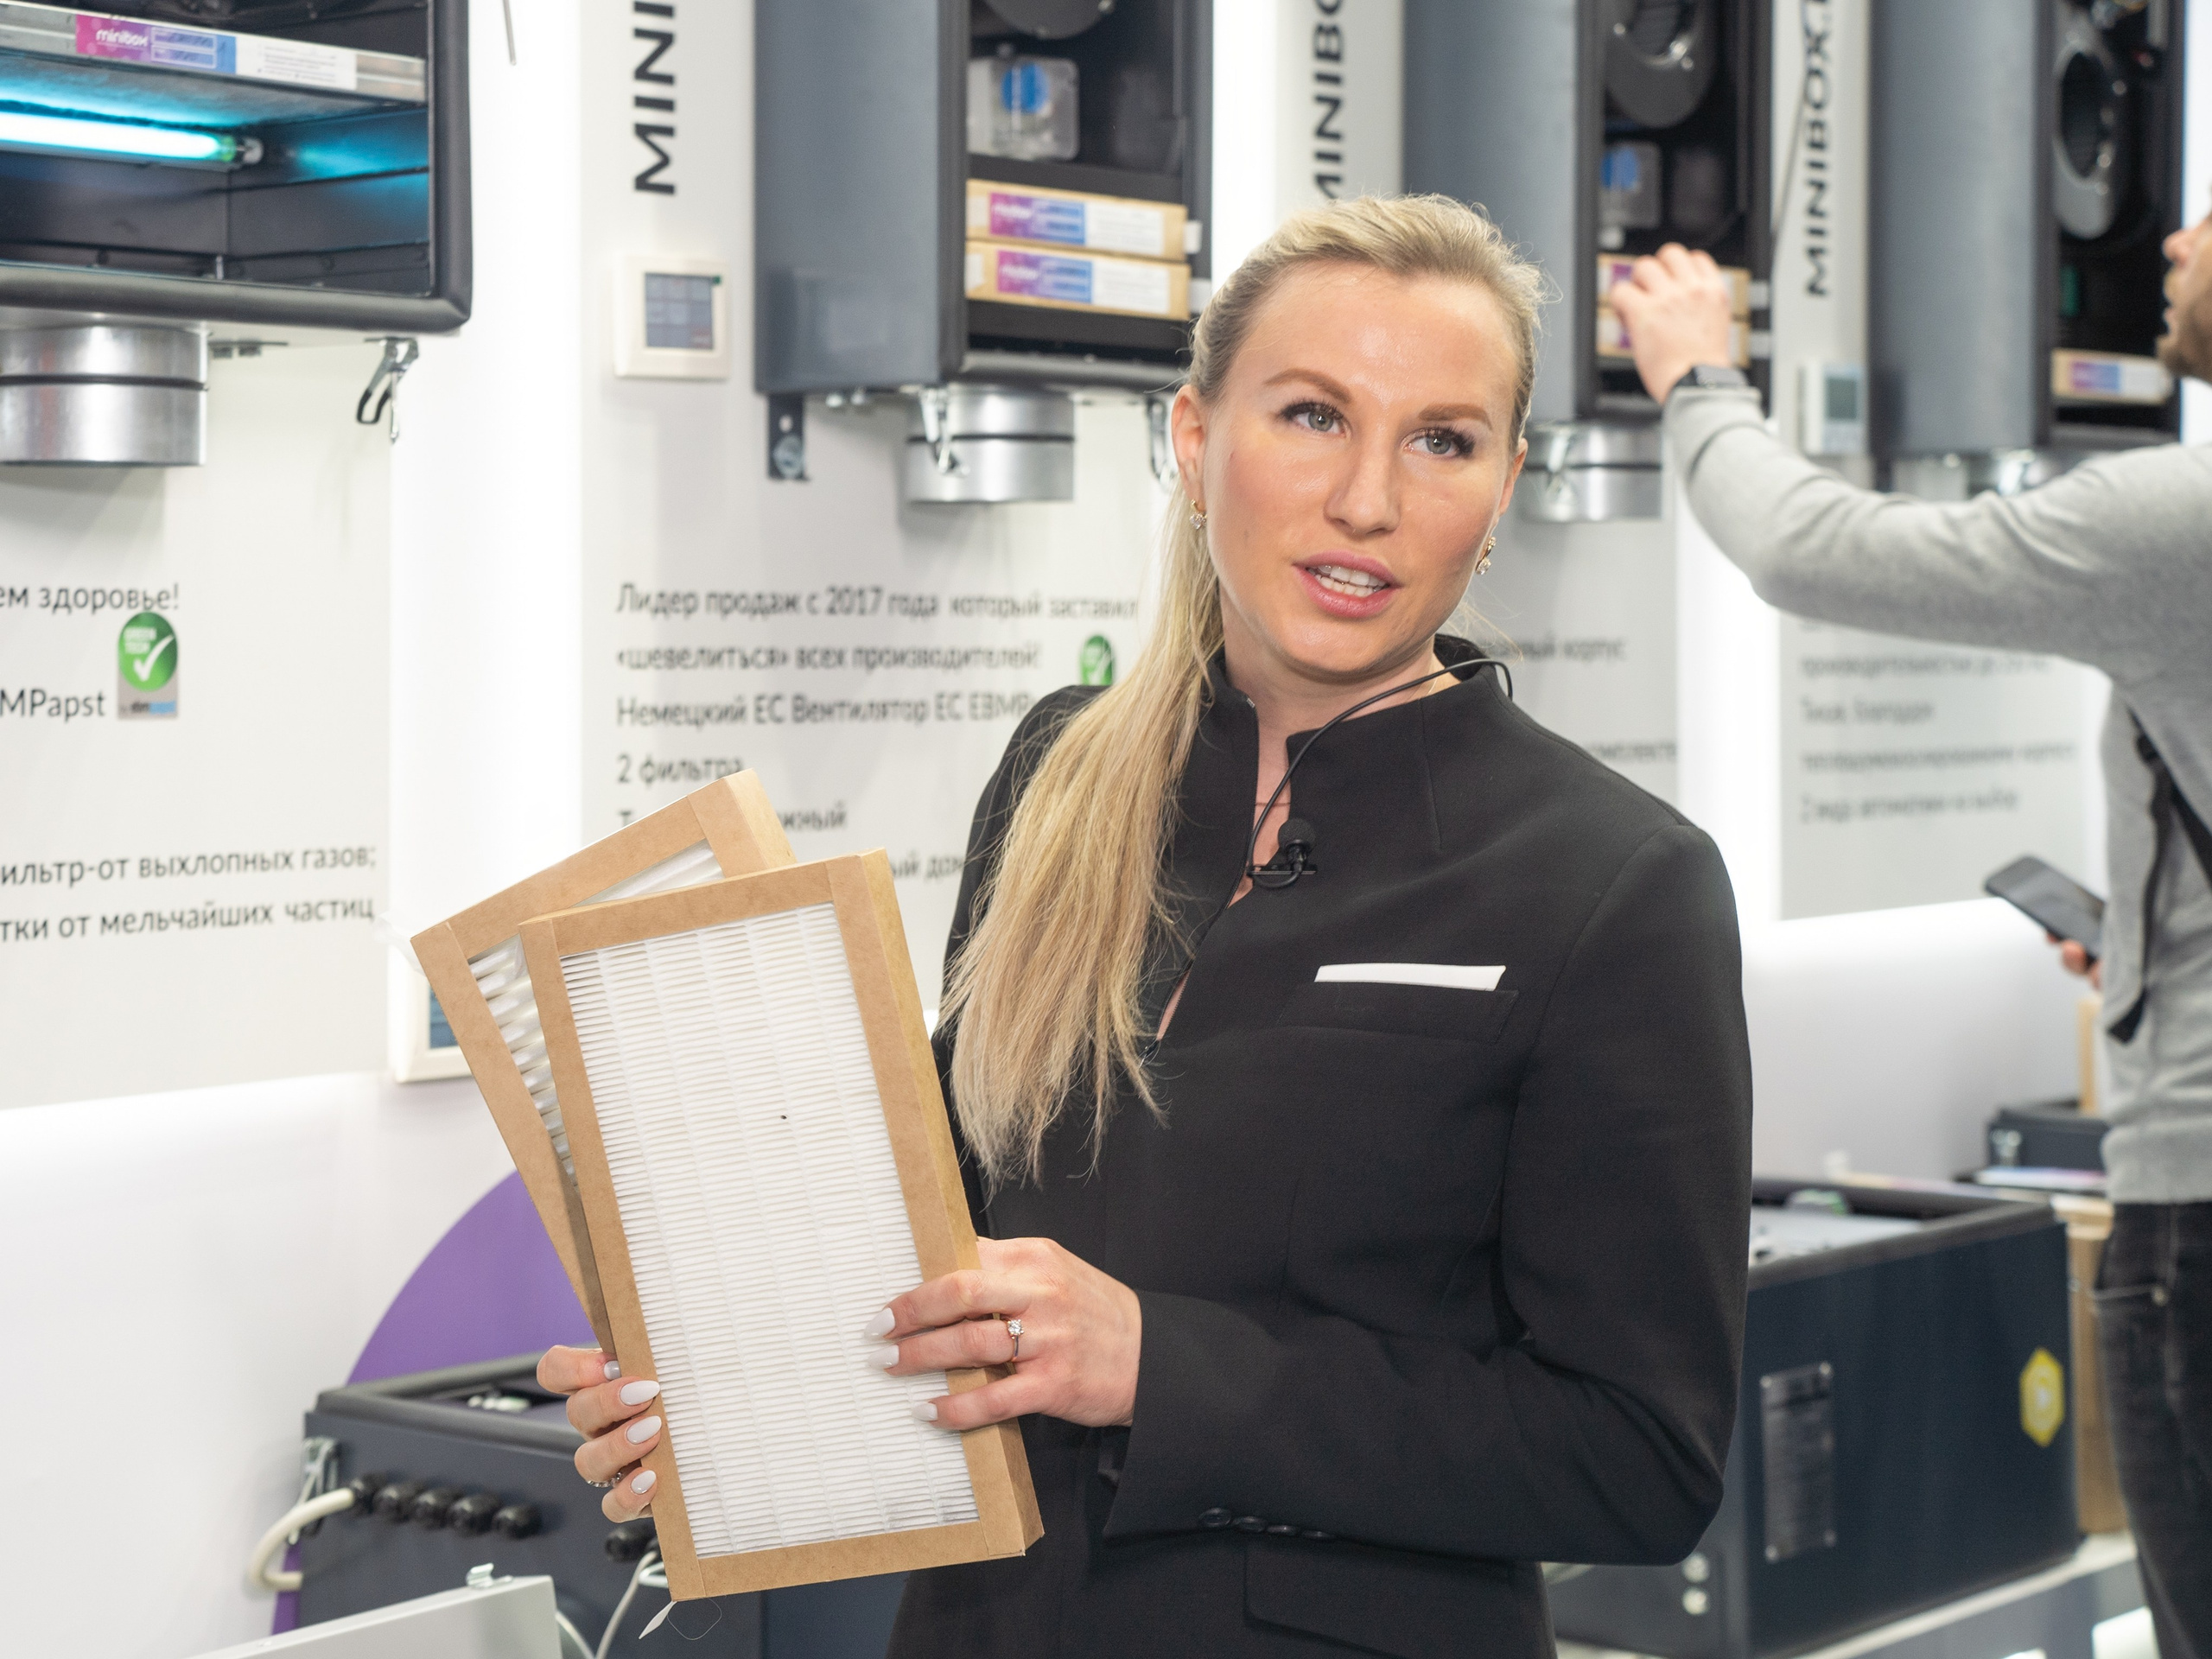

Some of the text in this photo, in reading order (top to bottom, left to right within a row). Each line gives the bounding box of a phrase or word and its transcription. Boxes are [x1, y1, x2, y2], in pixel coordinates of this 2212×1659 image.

[38, 582, 179, 616] здоровье!
[616, 583, 700, 620] Лидер
[705, 589, 801, 620] продаж
[806, 594, 820, 616] с
[826, 586, 884, 616] 2017
[888, 594, 938, 620] года
[950, 588, 1042, 621] который
[795, 648, 845, 670] всех
[0, 689, 105, 723] MPapst
[616, 693, 747, 728] Немецкий
[791, 693, 928, 723] Вентилятор
[618, 753, 631, 784] 2
[0, 845, 376, 888] ильтр-от выхлопных газов;
[58, 912, 92, 939] от
[99, 899, 274, 936] мельчайших
[284, 895, 375, 924] частиц
